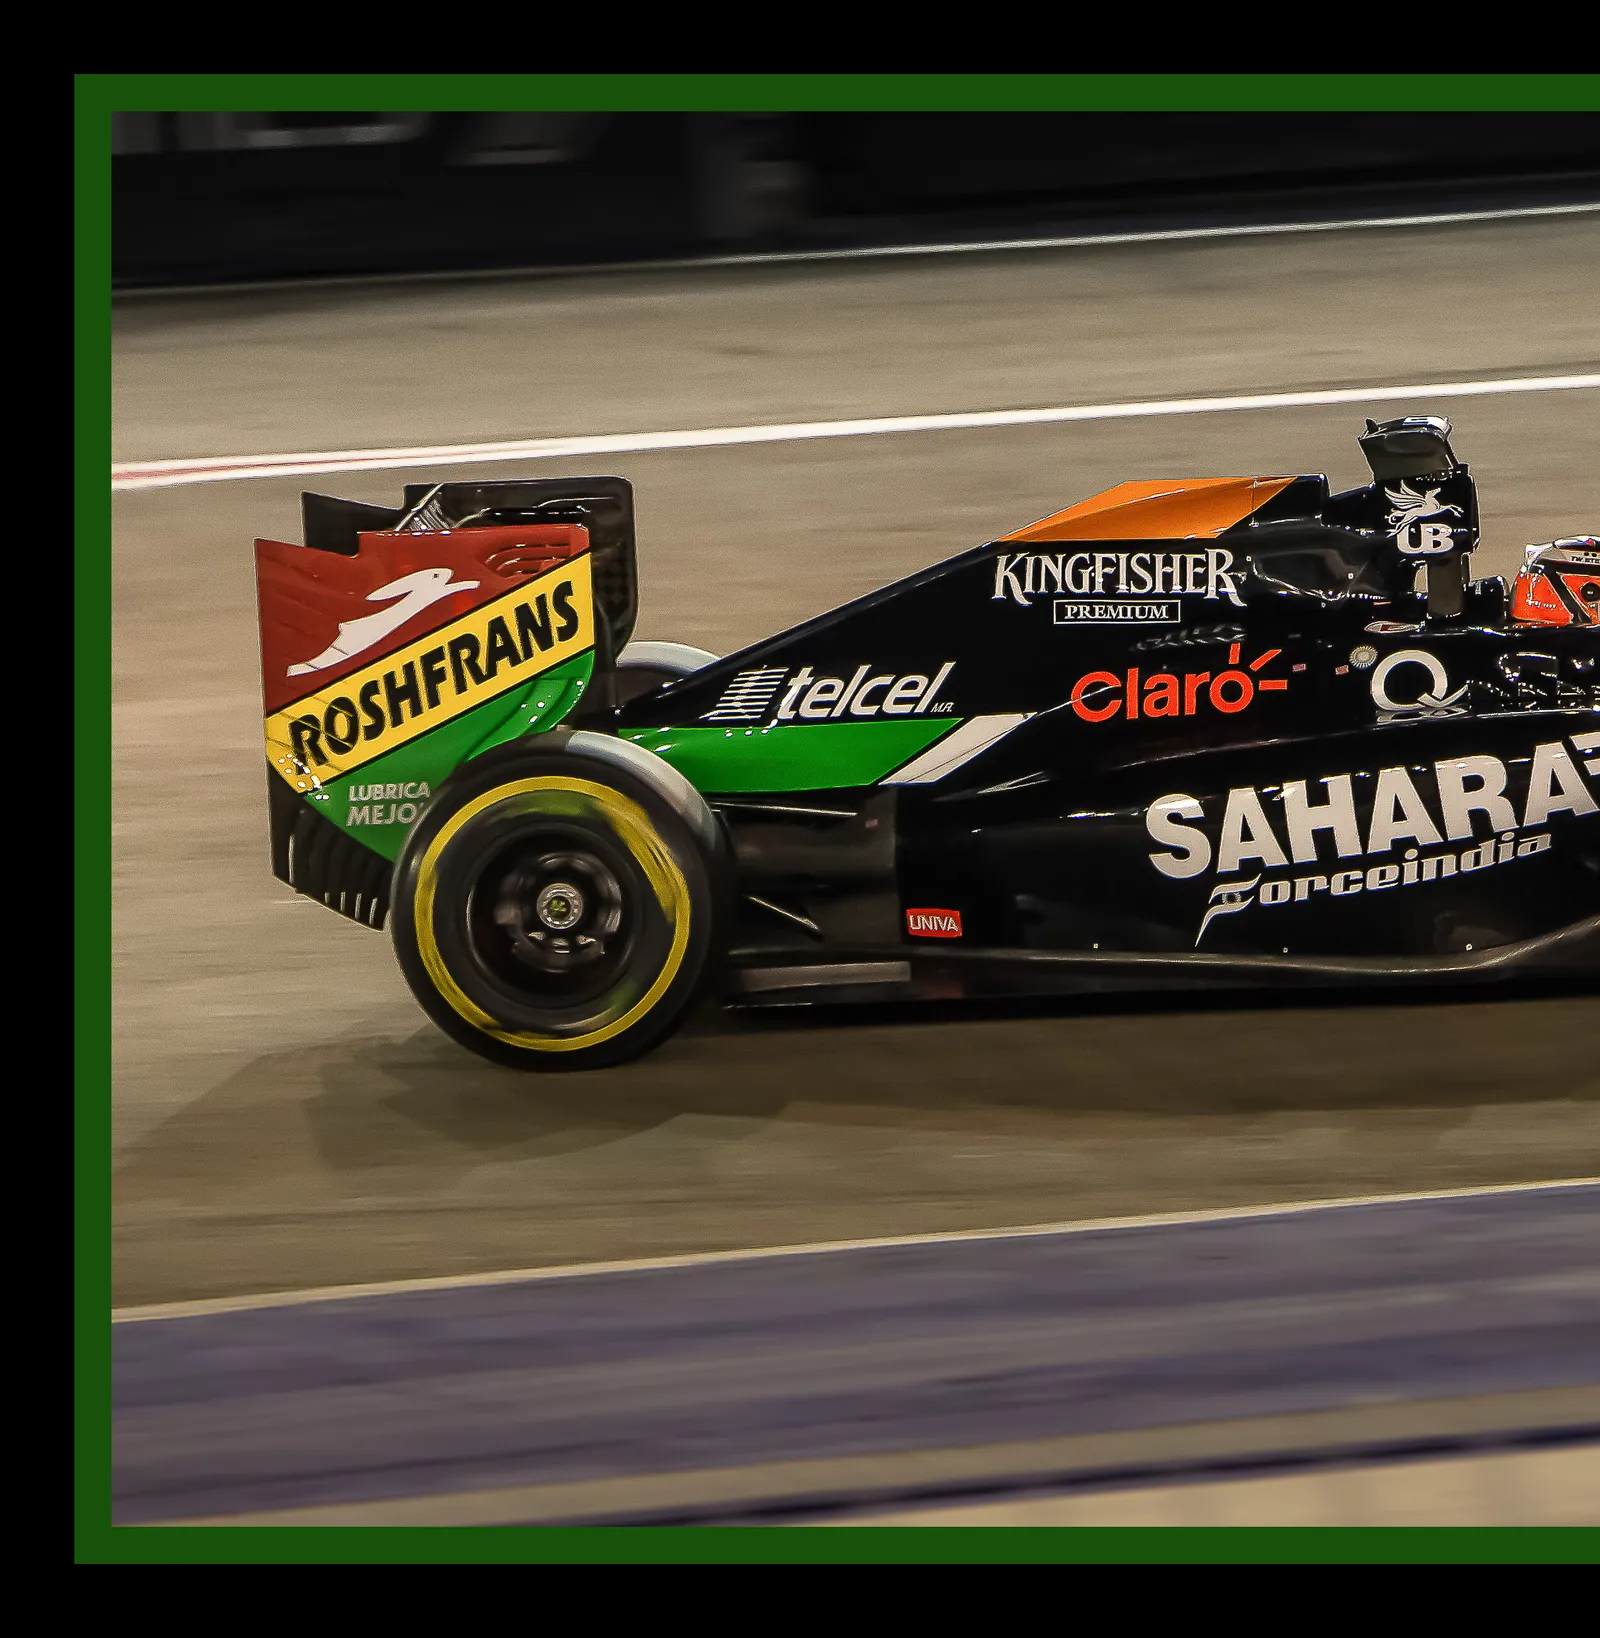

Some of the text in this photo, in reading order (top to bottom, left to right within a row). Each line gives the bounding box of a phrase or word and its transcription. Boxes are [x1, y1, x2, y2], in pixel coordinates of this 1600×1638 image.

[1397, 524, 1454, 554] UB
[991, 549, 1247, 606] KINGFISHER
[1065, 605, 1168, 619] PREMIUM
[286, 580, 579, 775] ROSHFRANS
[778, 661, 957, 718] telcel
[1071, 643, 1272, 723] Claro
[349, 782, 430, 802] LUBRICA
[1146, 741, 1600, 880] SAHARA
[346, 803, 425, 826] MEJO
[909, 915, 958, 932] UNIVA
